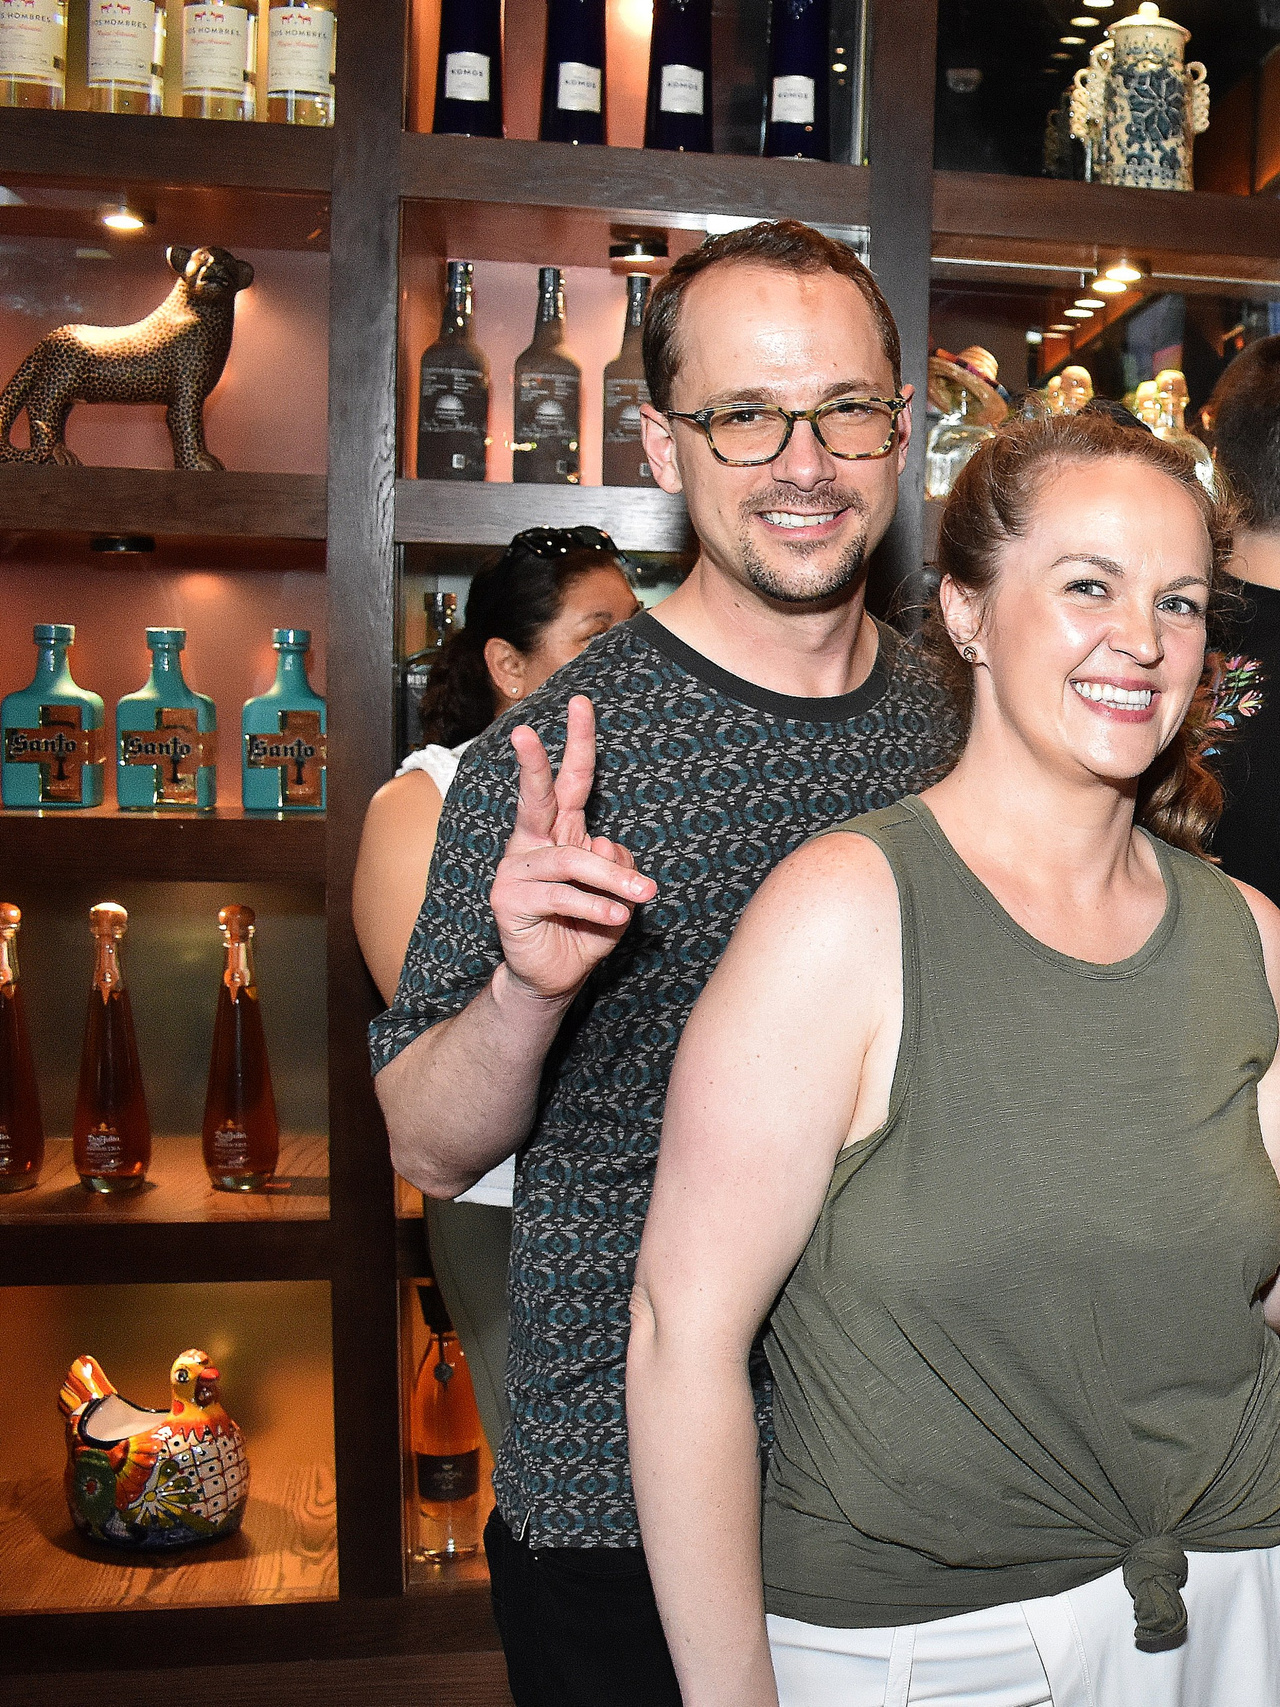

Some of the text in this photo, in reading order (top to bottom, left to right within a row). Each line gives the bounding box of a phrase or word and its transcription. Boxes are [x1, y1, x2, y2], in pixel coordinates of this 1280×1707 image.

[8, 12, 51, 23] HOMBRES
[104, 19, 148, 30] HOMBRES
[198, 26, 241, 37] HOMBRES
[451, 68, 484, 78] KOMOS
[565, 78, 597, 89] KOMOS
[10, 732, 77, 758] Santo
[125, 736, 191, 760] Santo
[251, 738, 314, 761] Santo
